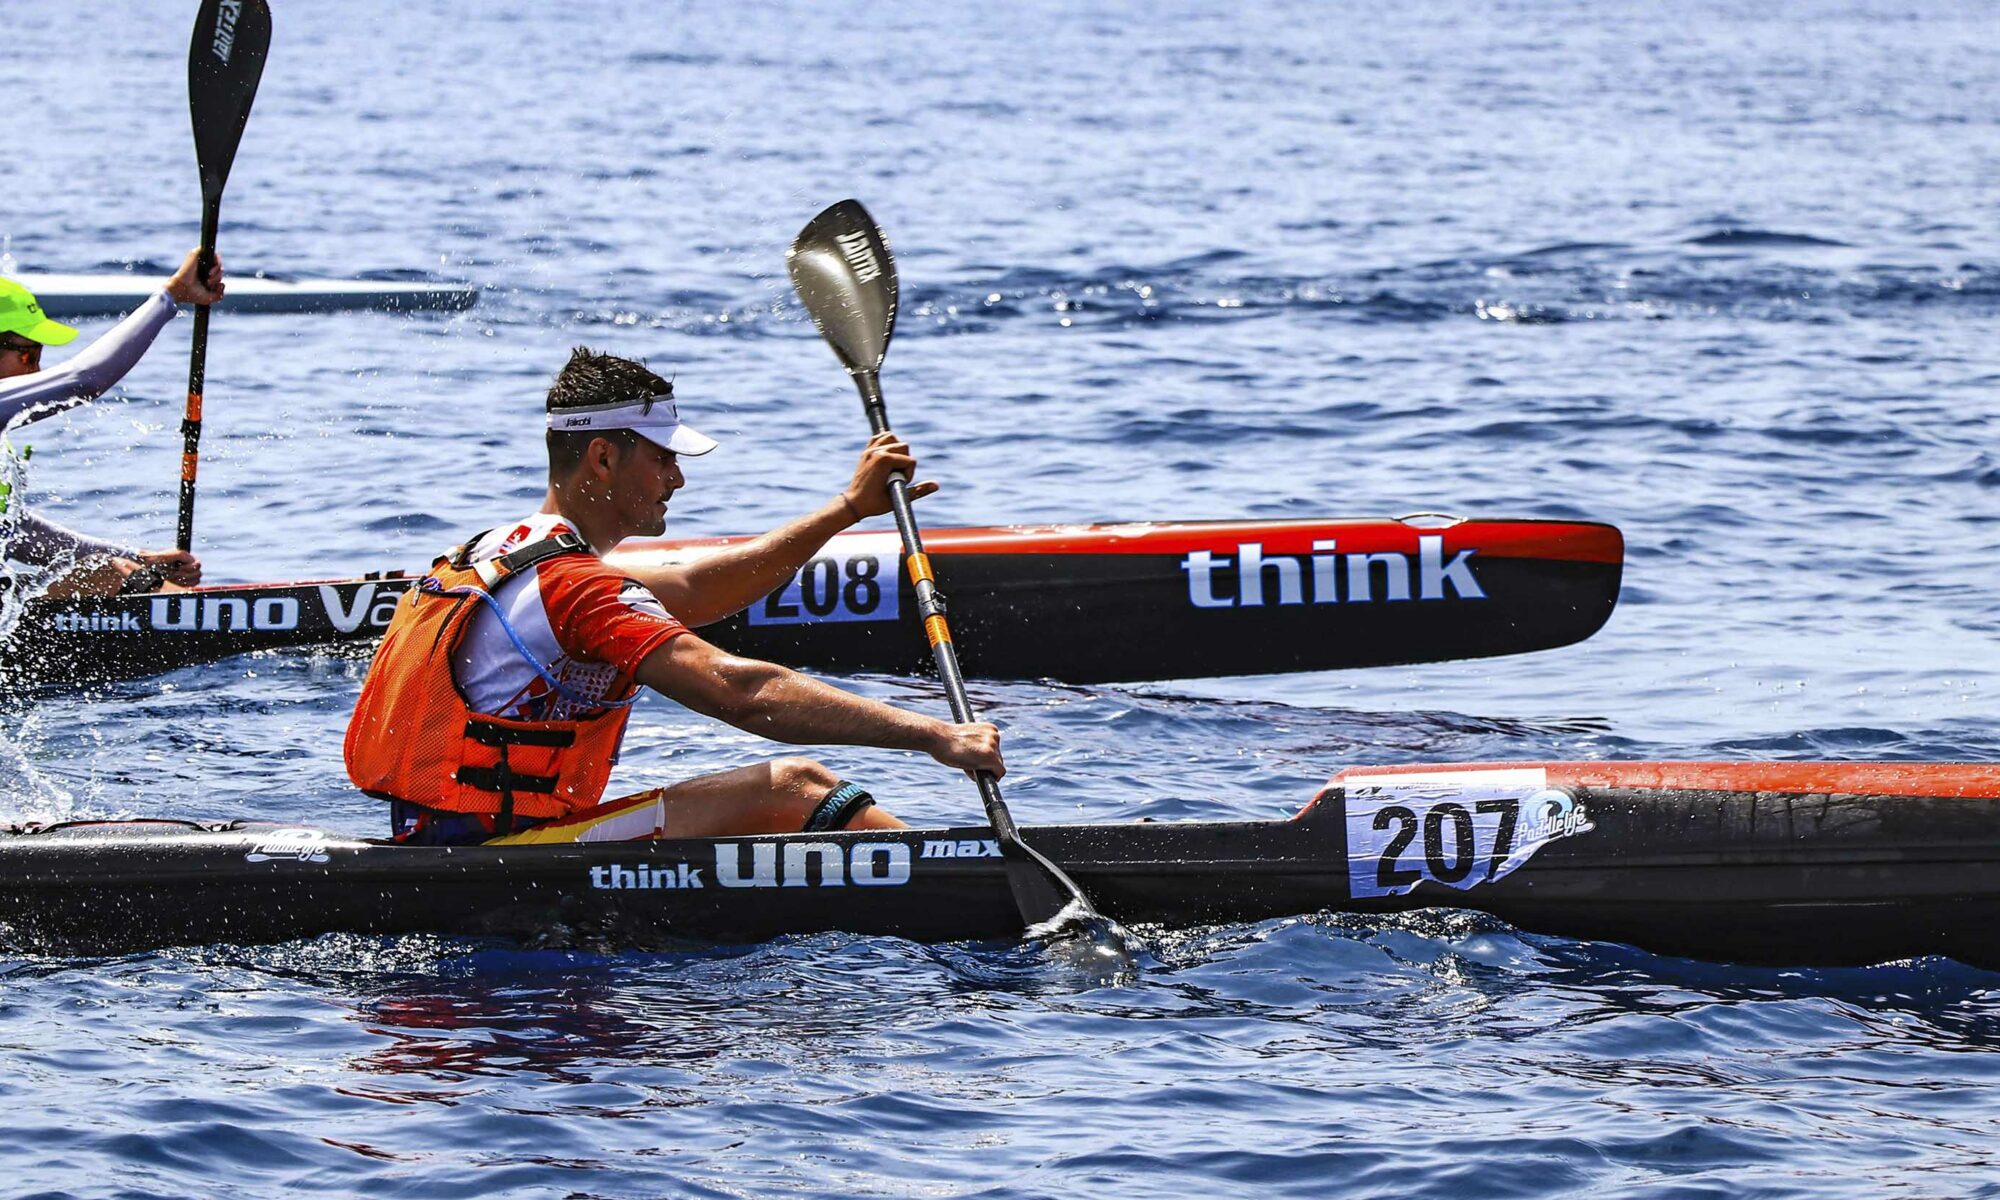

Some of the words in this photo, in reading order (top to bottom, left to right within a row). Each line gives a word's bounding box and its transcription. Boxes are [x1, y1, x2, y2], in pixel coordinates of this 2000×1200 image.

[1181, 535, 1488, 607] think
[53, 611, 142, 632] think
[151, 597, 299, 631] uno
[589, 863, 704, 889] think
[714, 842, 911, 887] uno
[919, 839, 1004, 858] max
[1373, 798, 1519, 888] 207
